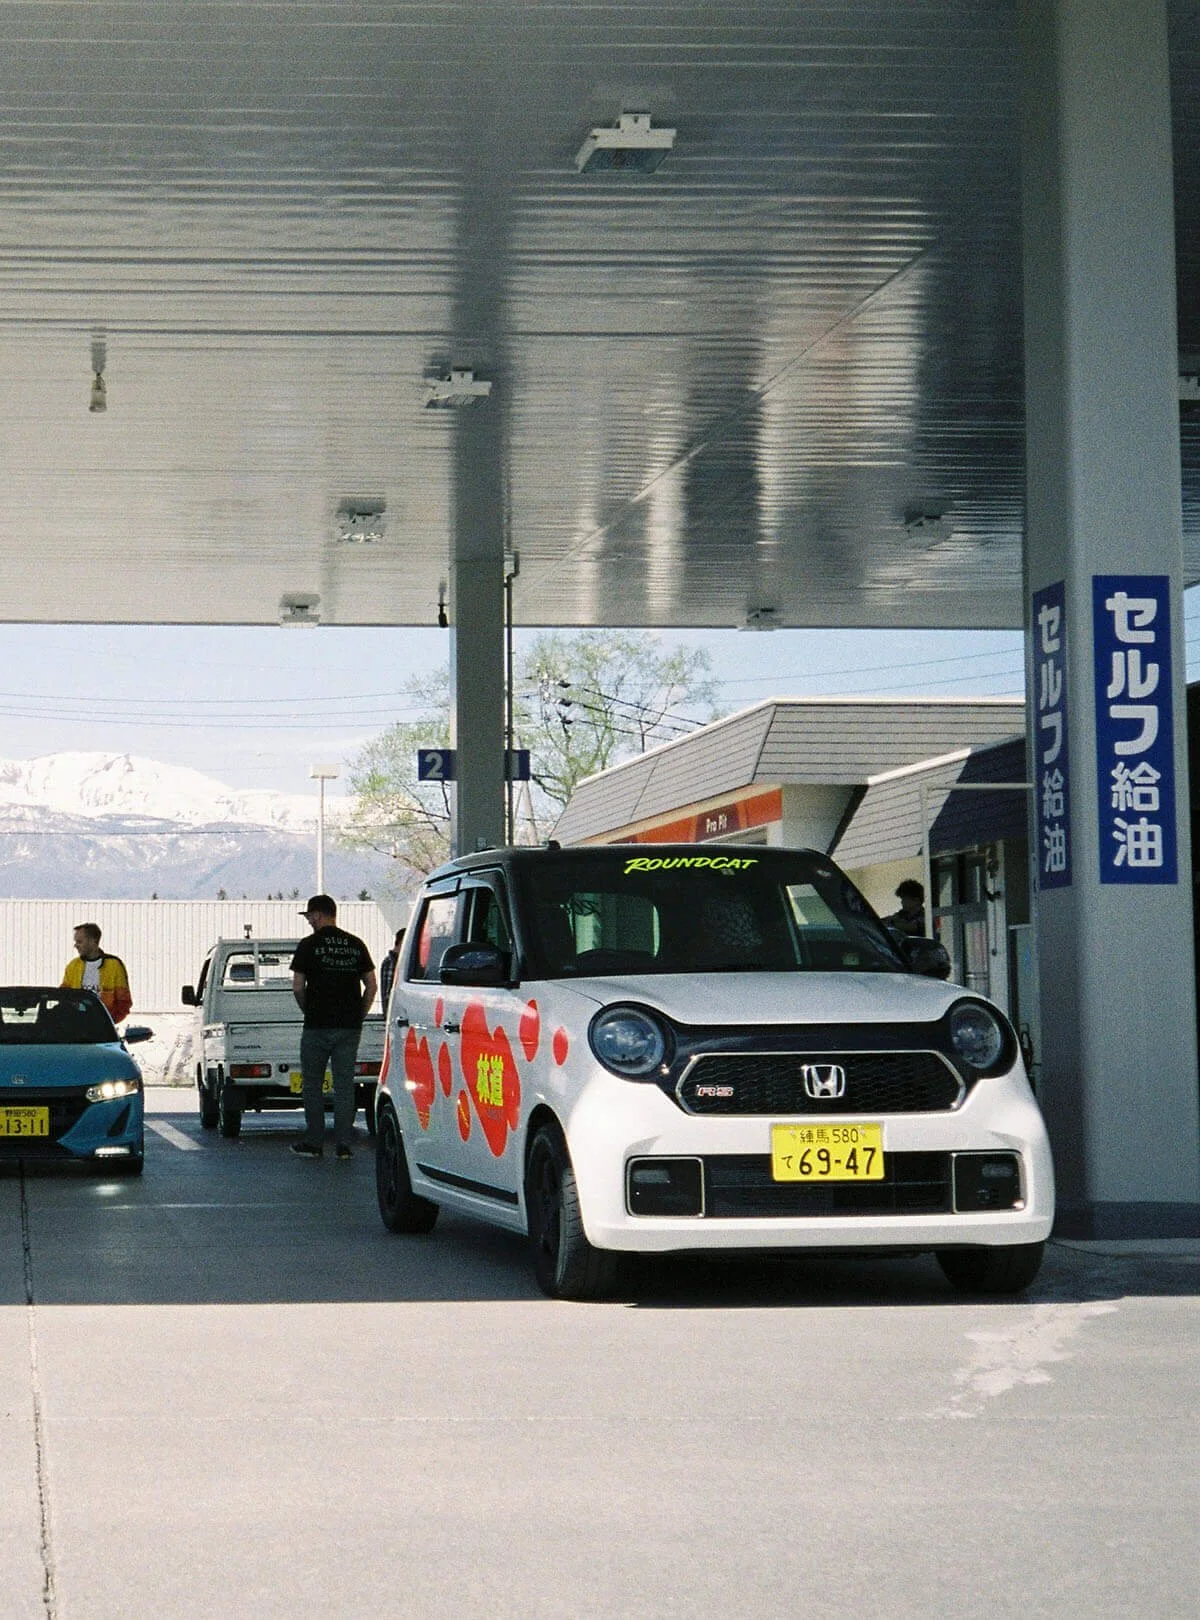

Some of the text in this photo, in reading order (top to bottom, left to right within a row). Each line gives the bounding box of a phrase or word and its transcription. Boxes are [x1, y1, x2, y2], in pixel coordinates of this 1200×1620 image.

[1038, 604, 1066, 873] セルフ給油
[1105, 591, 1163, 867] セルフ給油
[424, 752, 443, 779] 2
[623, 856, 759, 874] ROUNDCAT
[697, 1086, 734, 1096] RS
[781, 1147, 876, 1175] て 69-47
